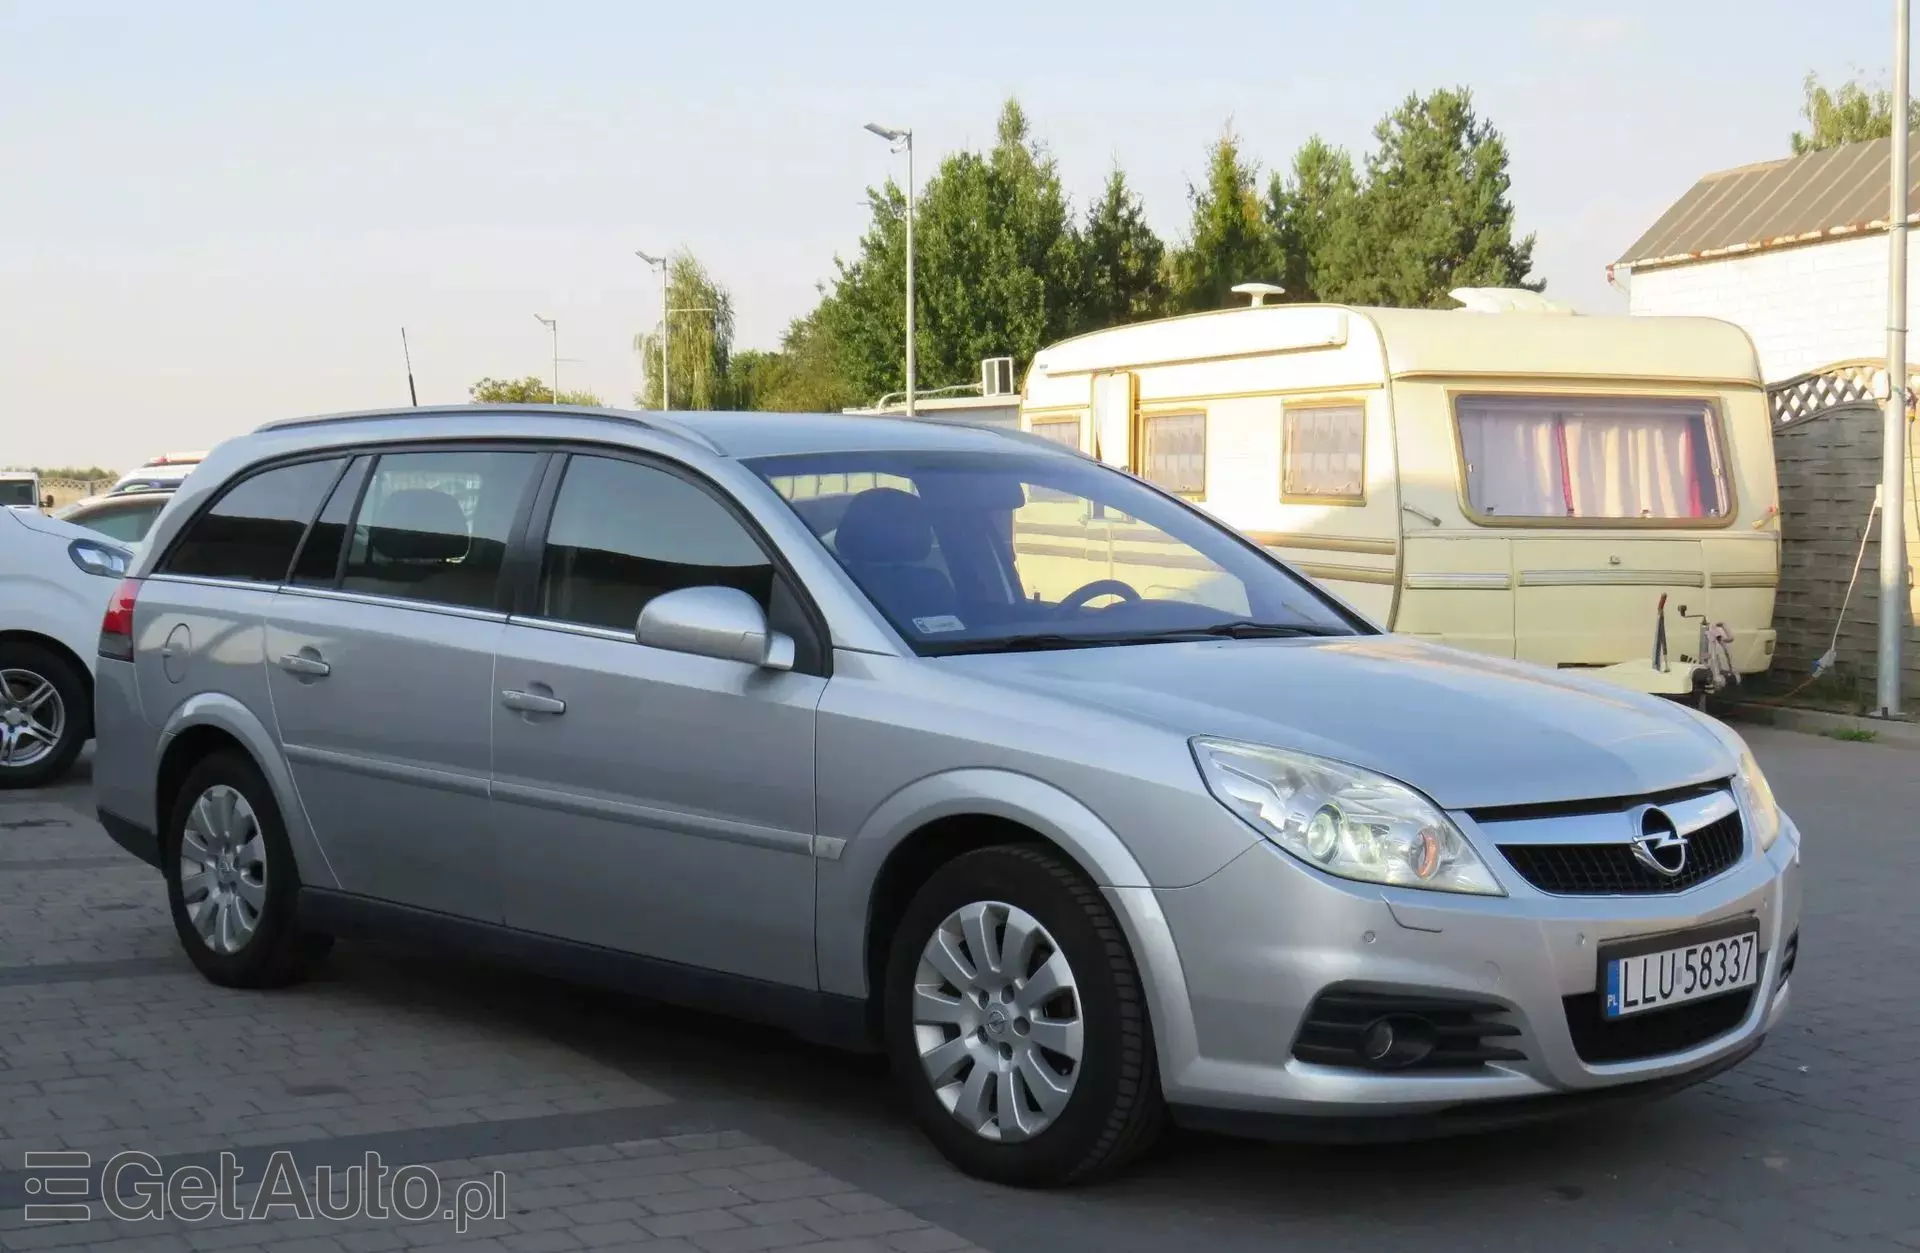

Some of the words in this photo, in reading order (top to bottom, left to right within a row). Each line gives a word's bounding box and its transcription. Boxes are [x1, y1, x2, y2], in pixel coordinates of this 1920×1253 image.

[1623, 953, 1675, 1007] LLU
[1684, 936, 1754, 994] 58337
[1607, 994, 1618, 1008] PL
